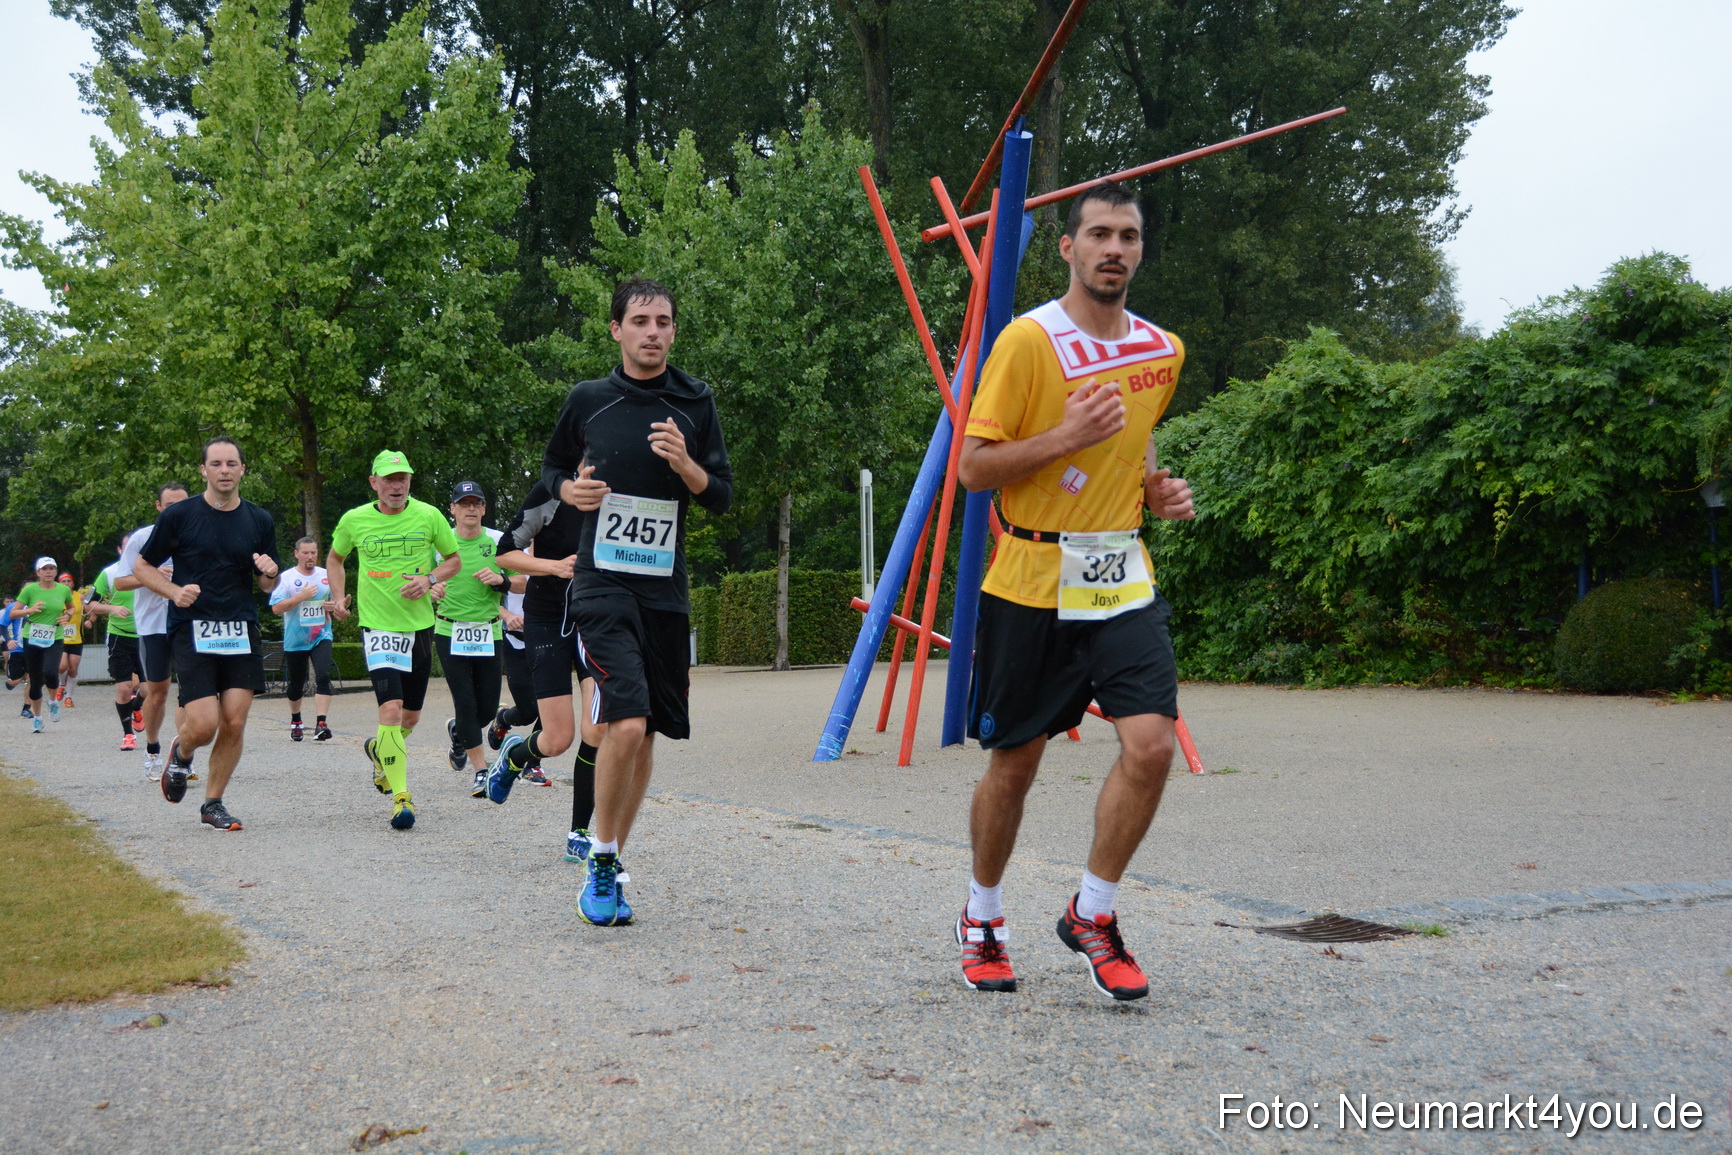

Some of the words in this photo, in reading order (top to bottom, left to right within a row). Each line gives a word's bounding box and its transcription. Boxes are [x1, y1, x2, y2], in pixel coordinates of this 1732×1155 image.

[605, 513, 673, 547] 2457
[614, 548, 657, 564] Michael
[1082, 552, 1127, 583] 323
[1091, 593, 1120, 606] Joan
[302, 607, 324, 617] 2011
[32, 628, 54, 640] 2527
[64, 628, 74, 636] 09
[200, 621, 243, 638] 2419
[456, 628, 489, 642] 2097
[207, 641, 239, 649] Johannes
[370, 635, 411, 654] 2850
